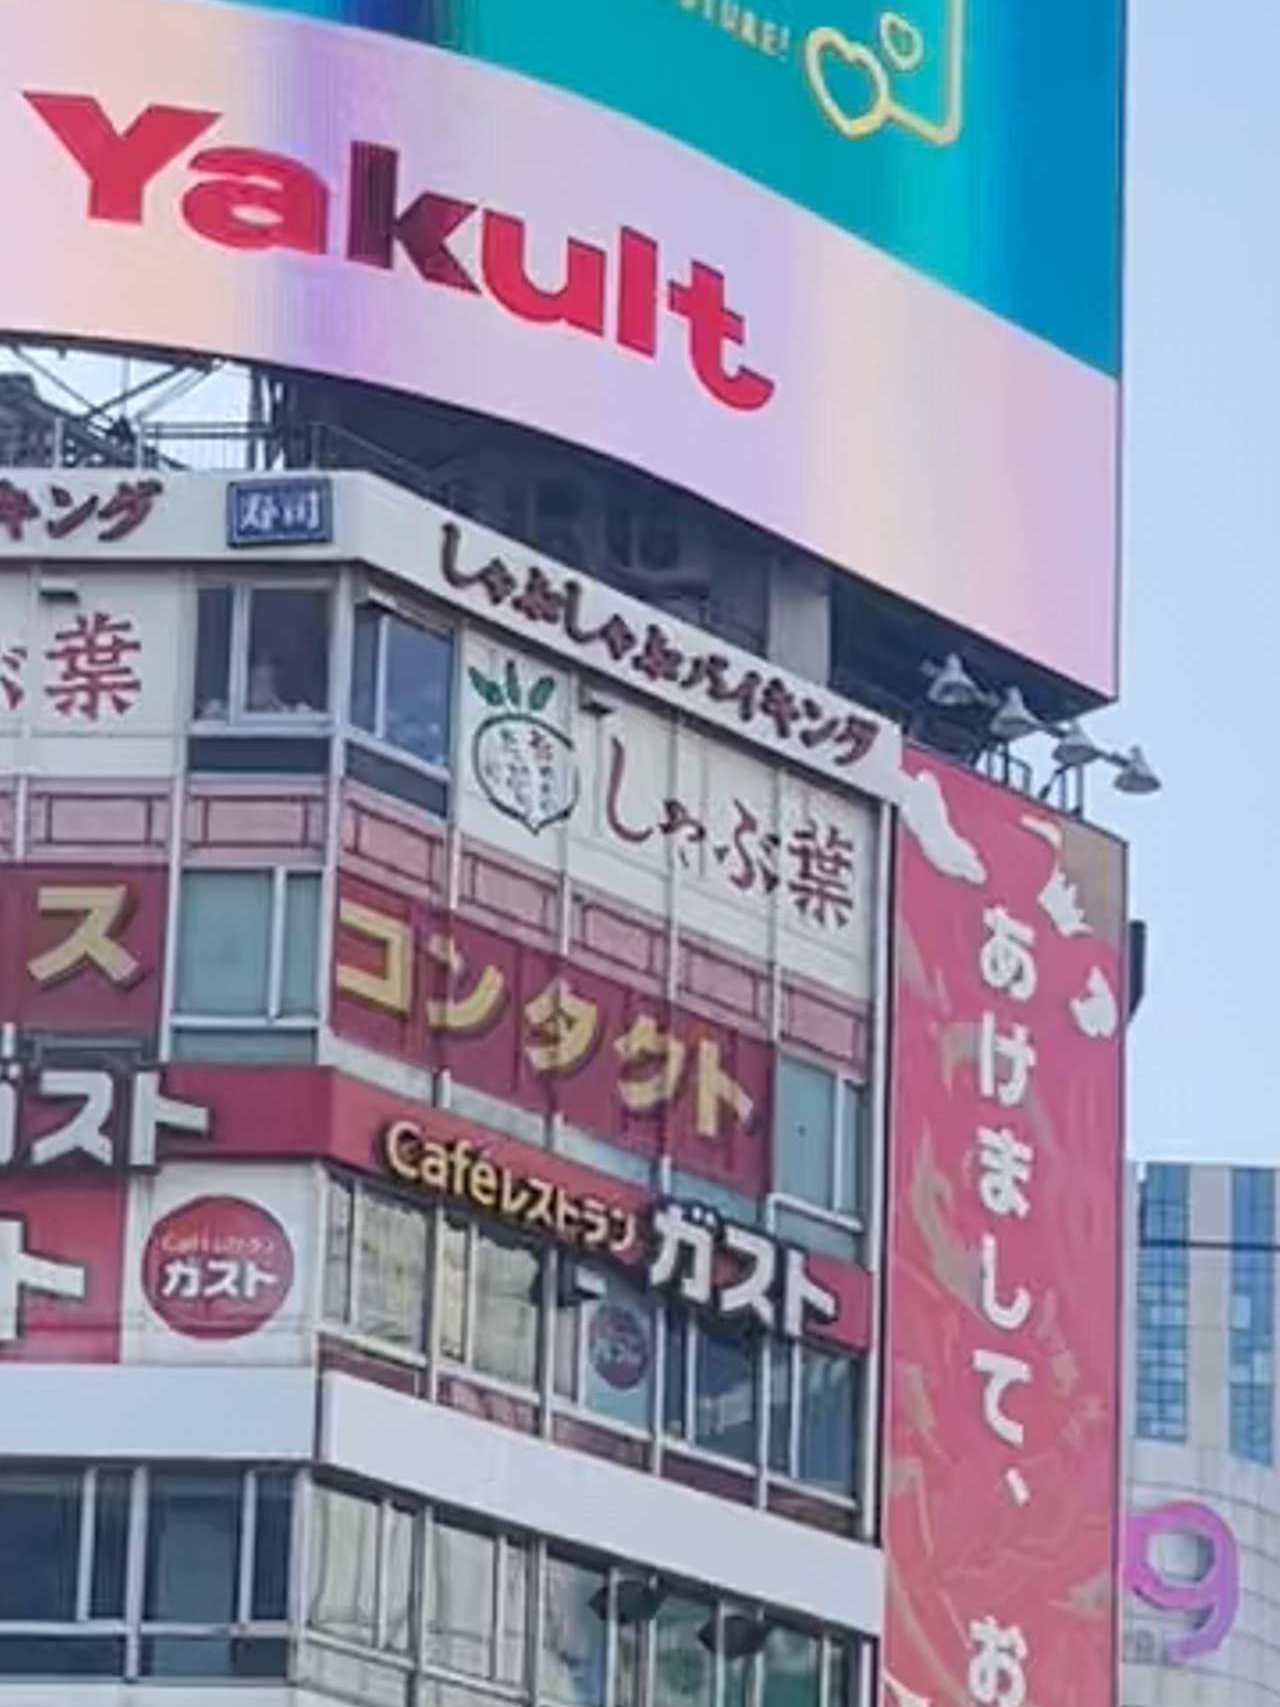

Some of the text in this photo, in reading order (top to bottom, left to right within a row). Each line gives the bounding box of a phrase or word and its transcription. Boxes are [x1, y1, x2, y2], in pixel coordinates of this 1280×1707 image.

[20, 90, 774, 412] Yakult
[439, 521, 881, 768] しゃぶしゃぶバイキング
[606, 735, 855, 930] しゃぶ葉
[336, 899, 755, 1136] コンタクト
[162, 1258, 277, 1298] ガスト
[651, 1206, 838, 1337] ガスト
